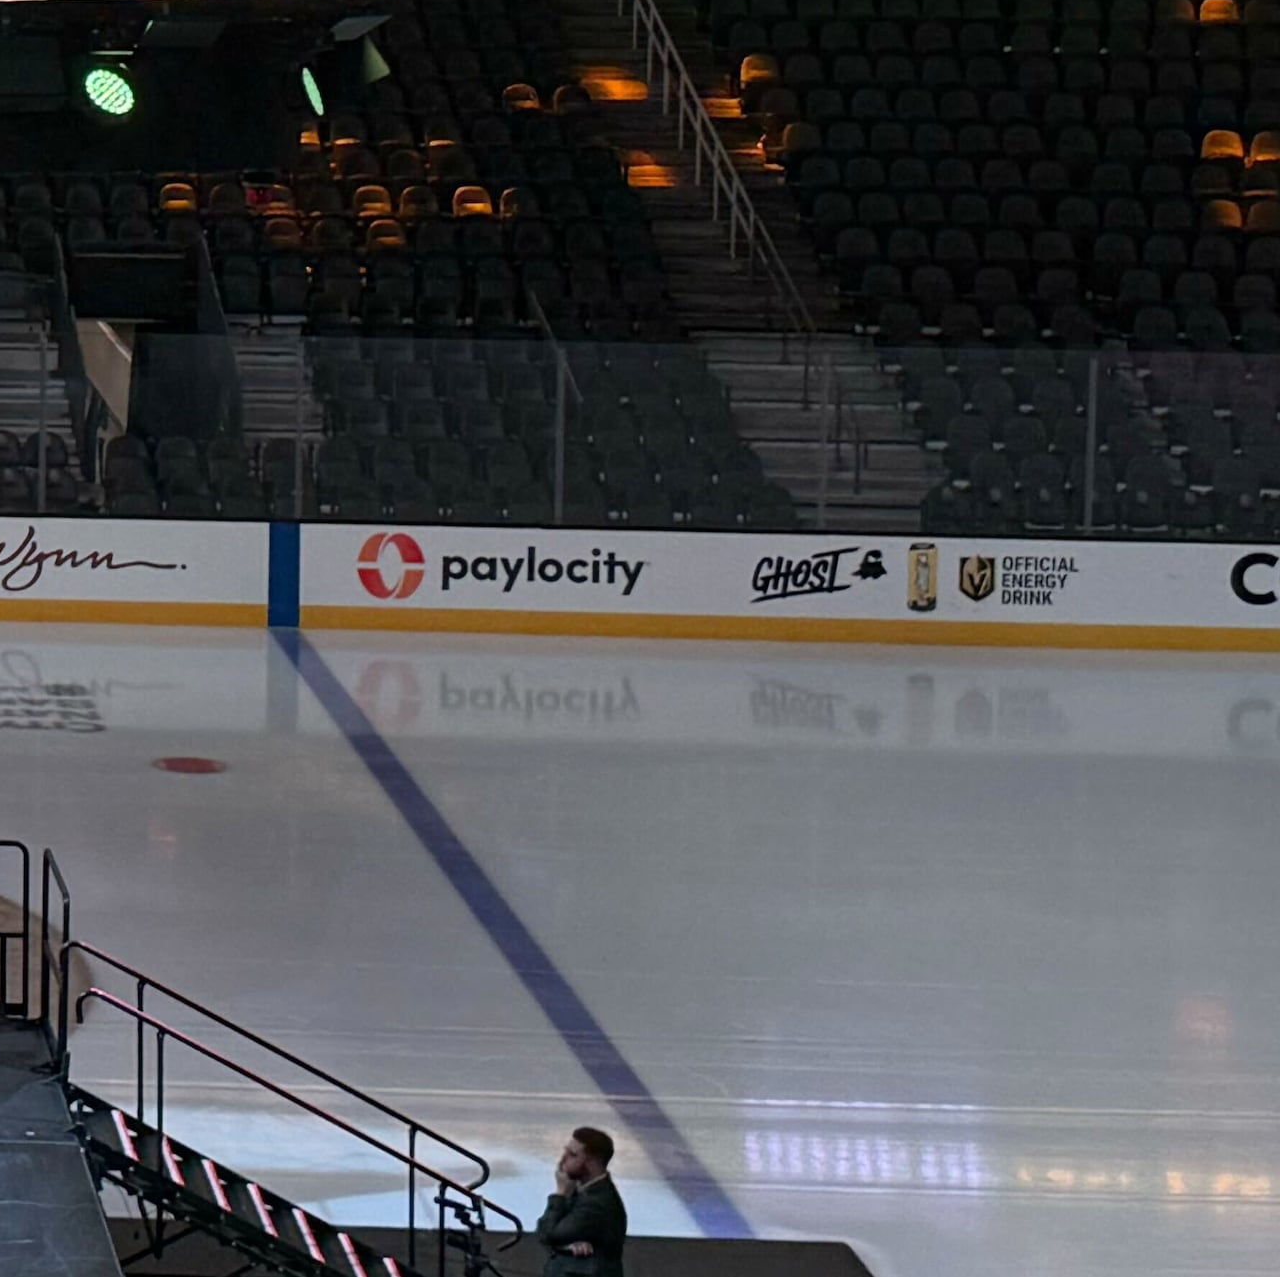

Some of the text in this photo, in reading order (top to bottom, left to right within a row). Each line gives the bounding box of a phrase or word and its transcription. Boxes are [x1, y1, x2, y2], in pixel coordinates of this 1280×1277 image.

[441, 546, 645, 596] paylocity
[1001, 556, 1080, 573] OFFICIAL
[751, 547, 861, 604] GHOST
[1001, 573, 1068, 590] ENERGY
[1001, 590, 1053, 605] DRINK
